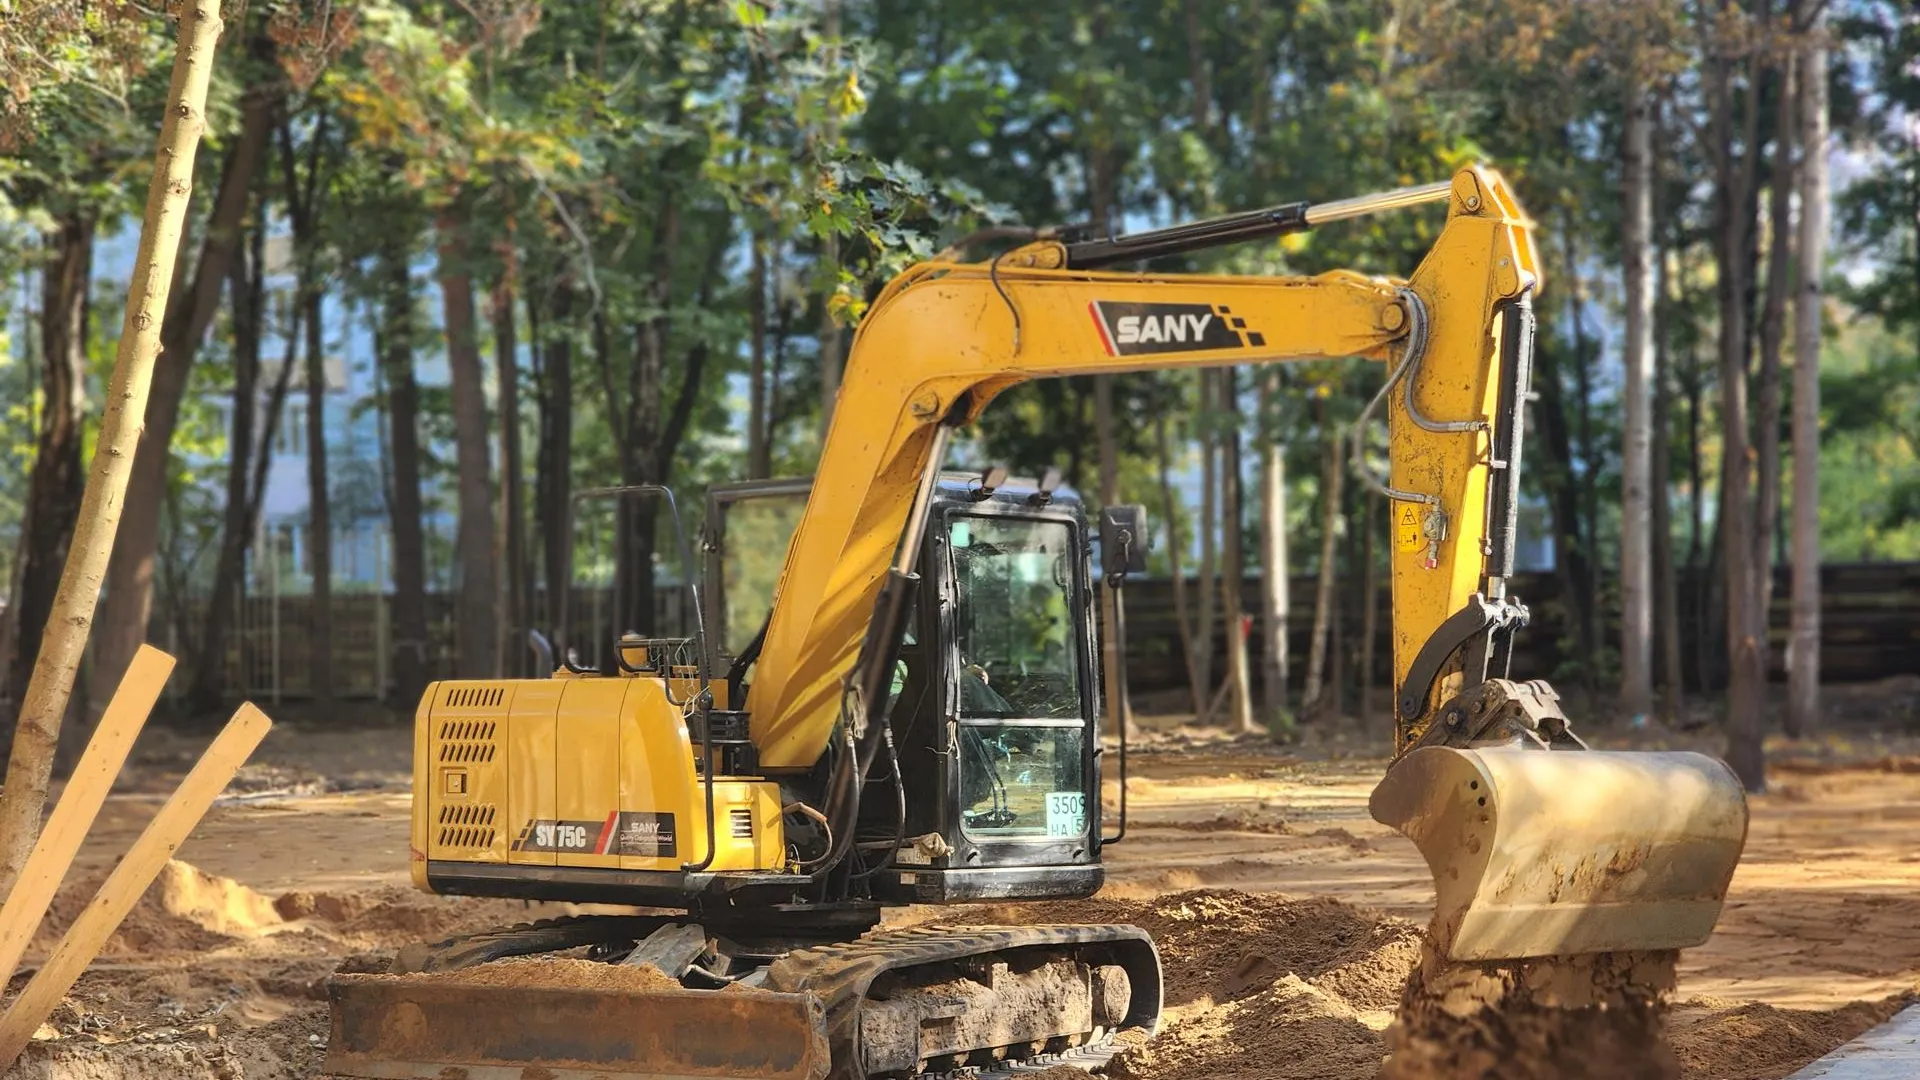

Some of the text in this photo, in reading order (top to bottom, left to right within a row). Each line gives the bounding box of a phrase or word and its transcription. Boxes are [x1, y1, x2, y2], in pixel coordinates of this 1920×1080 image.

[1117, 313, 1213, 344] SANY
[1052, 796, 1086, 815] 3509
[631, 822, 661, 834] SANY
